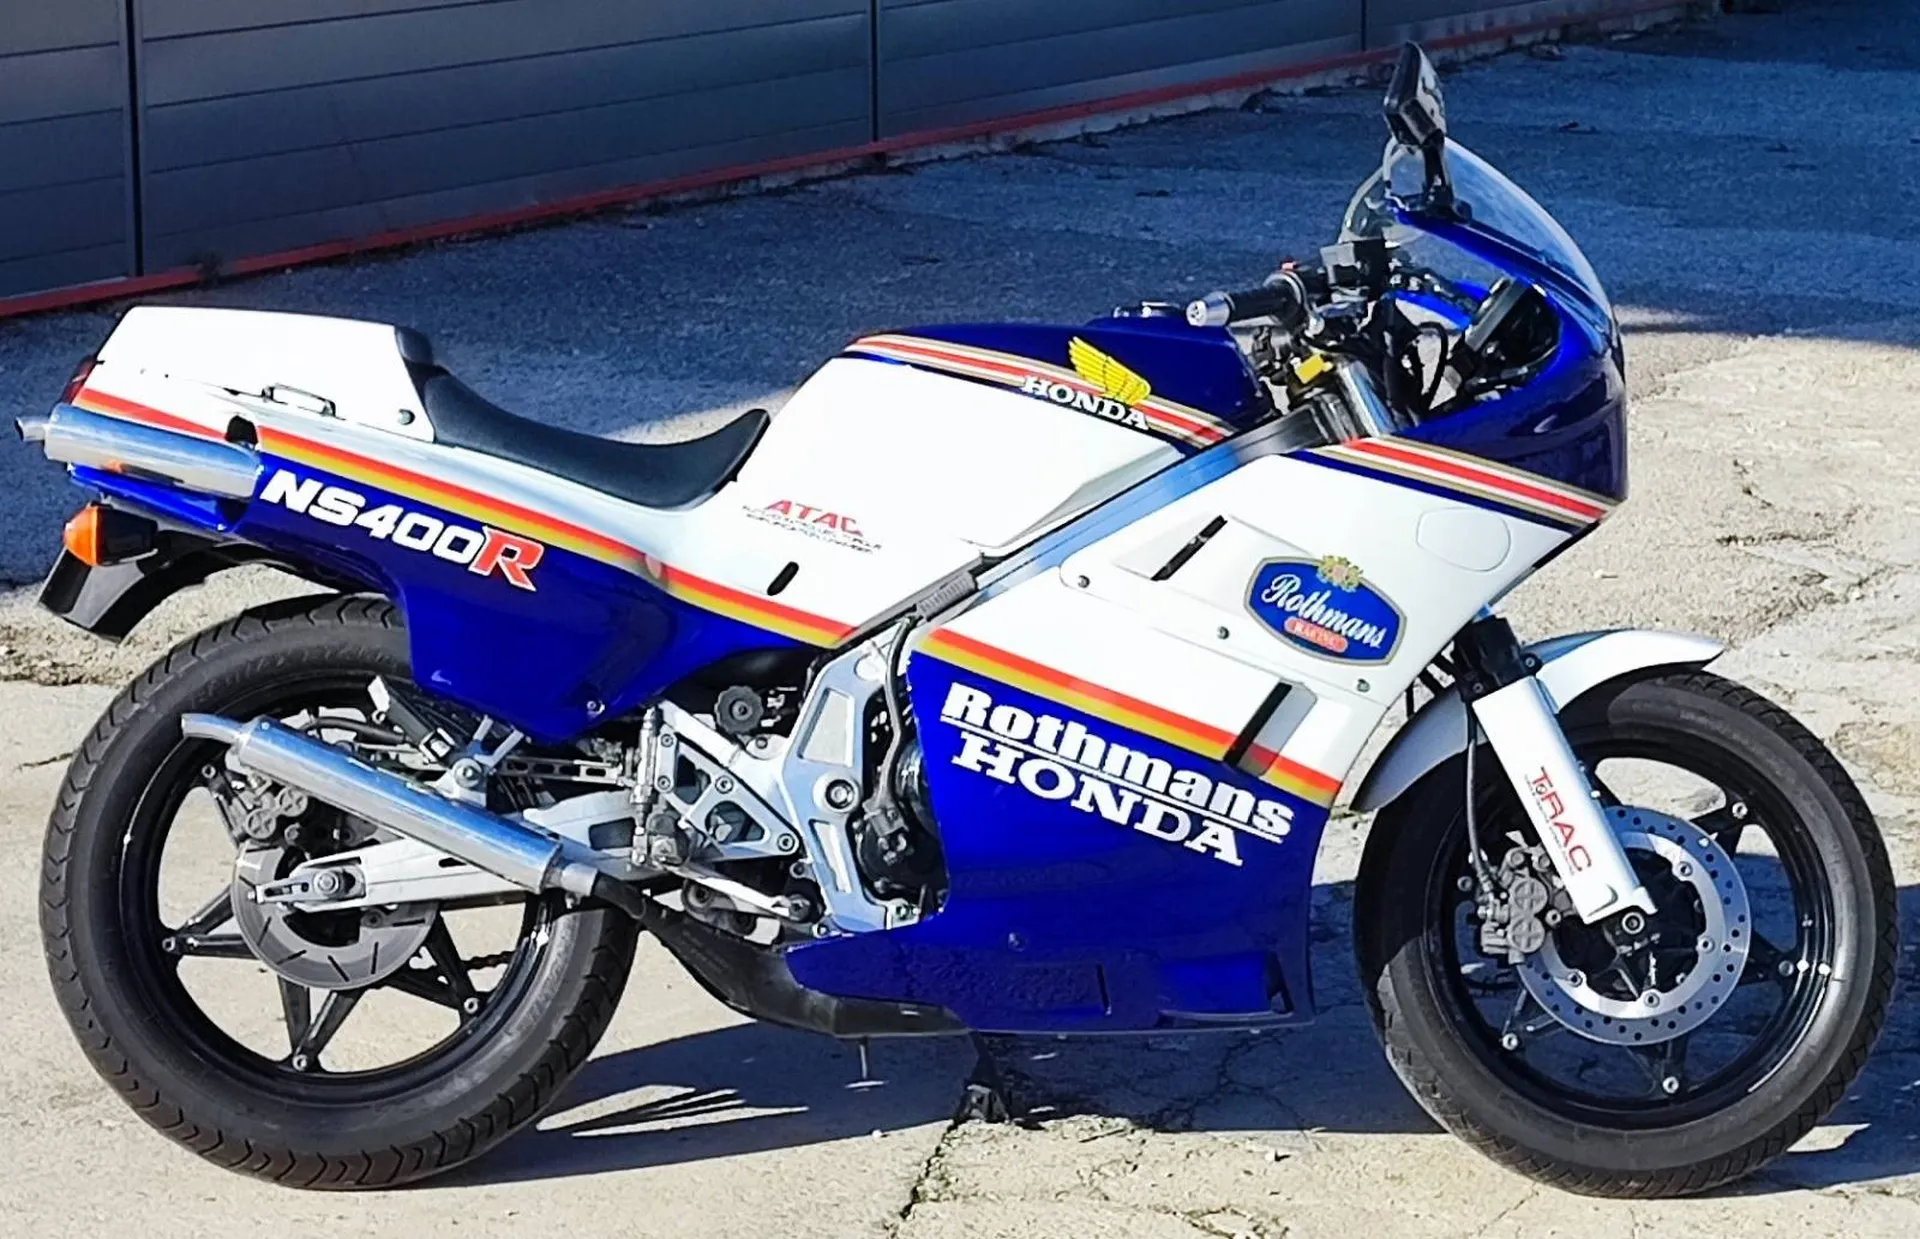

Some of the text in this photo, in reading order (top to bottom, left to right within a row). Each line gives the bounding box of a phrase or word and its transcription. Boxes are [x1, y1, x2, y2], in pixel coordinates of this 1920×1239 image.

[1021, 374, 1149, 430] HONDA
[259, 468, 545, 592] NS400R
[764, 499, 864, 537] ATAC
[1261, 573, 1387, 649] Rothmans
[940, 681, 1294, 838] Rothmans
[951, 731, 1243, 867] HONDA
